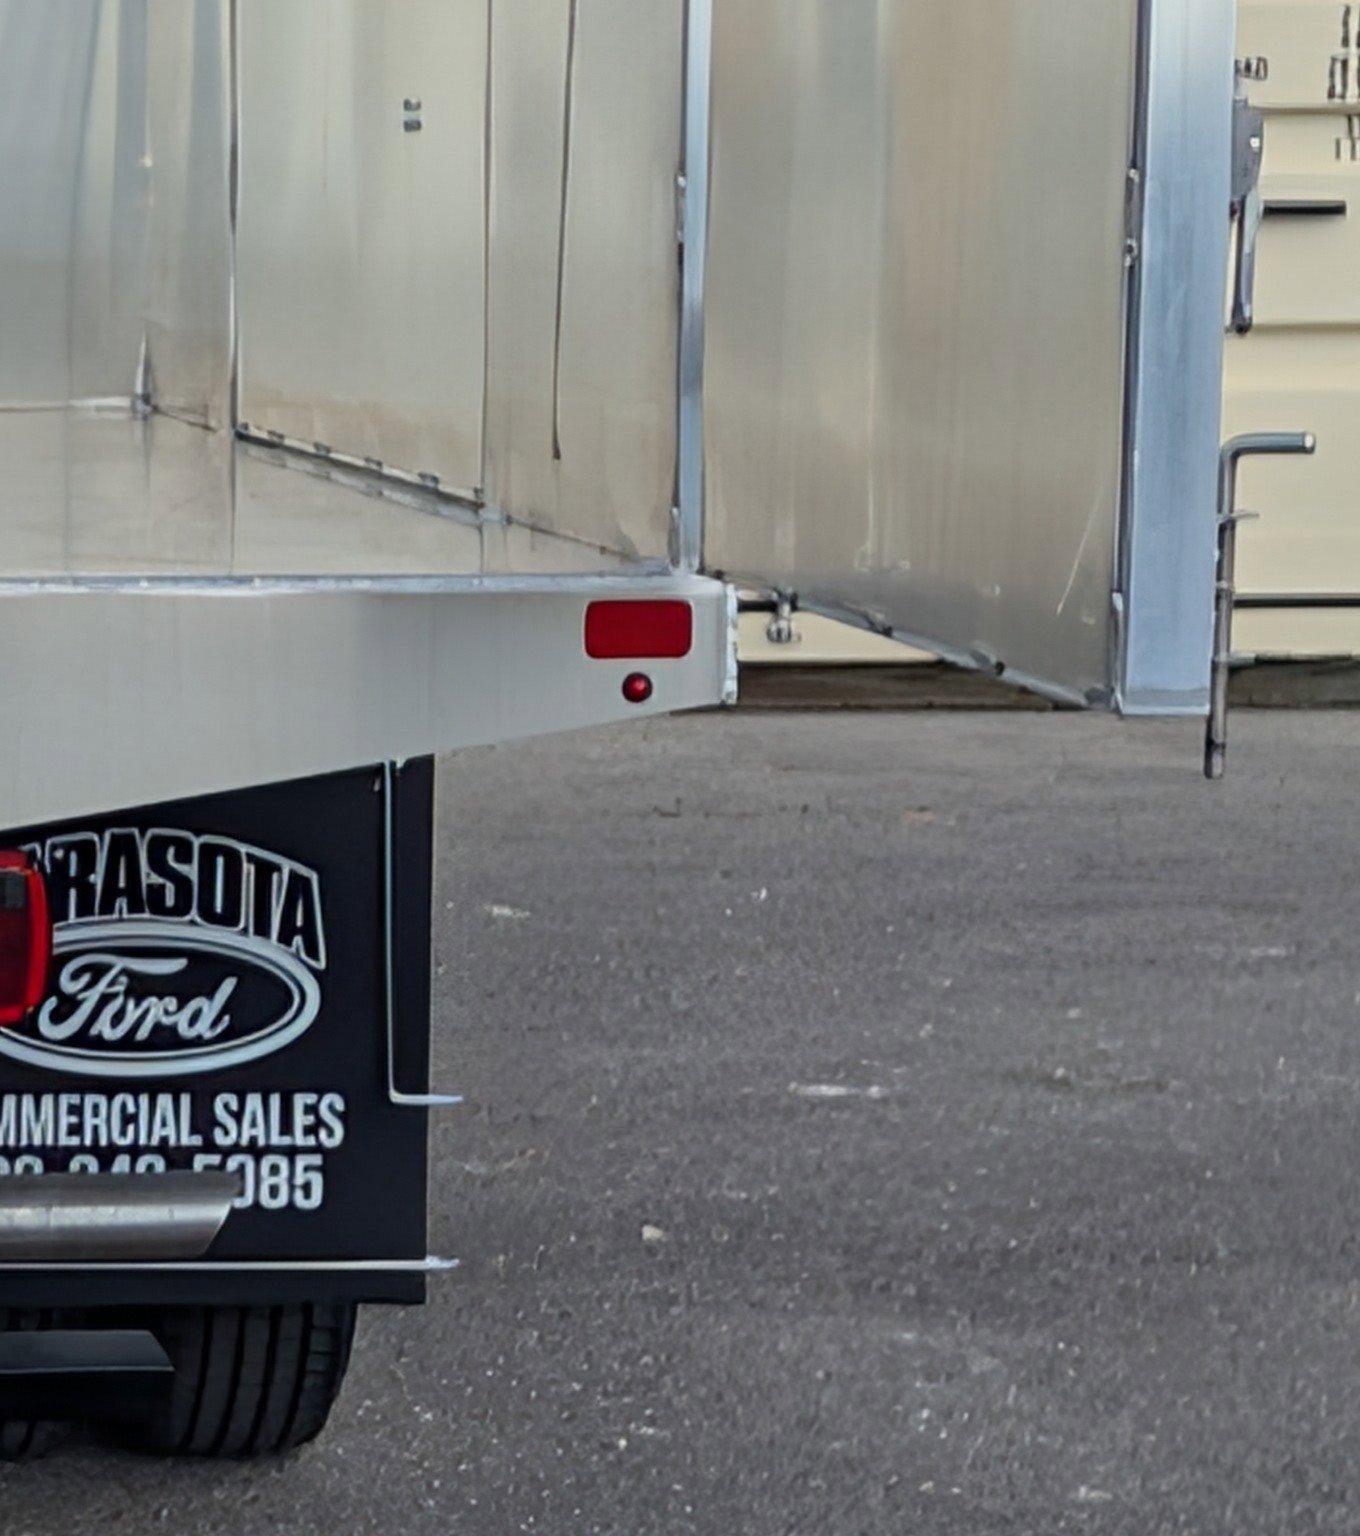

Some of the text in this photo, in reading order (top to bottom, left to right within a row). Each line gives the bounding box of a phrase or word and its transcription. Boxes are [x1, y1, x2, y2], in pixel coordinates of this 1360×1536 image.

[25, 827, 326, 970] RASOTA
[38, 953, 238, 1041] Ford
[214, 1092, 346, 1148] SALES
